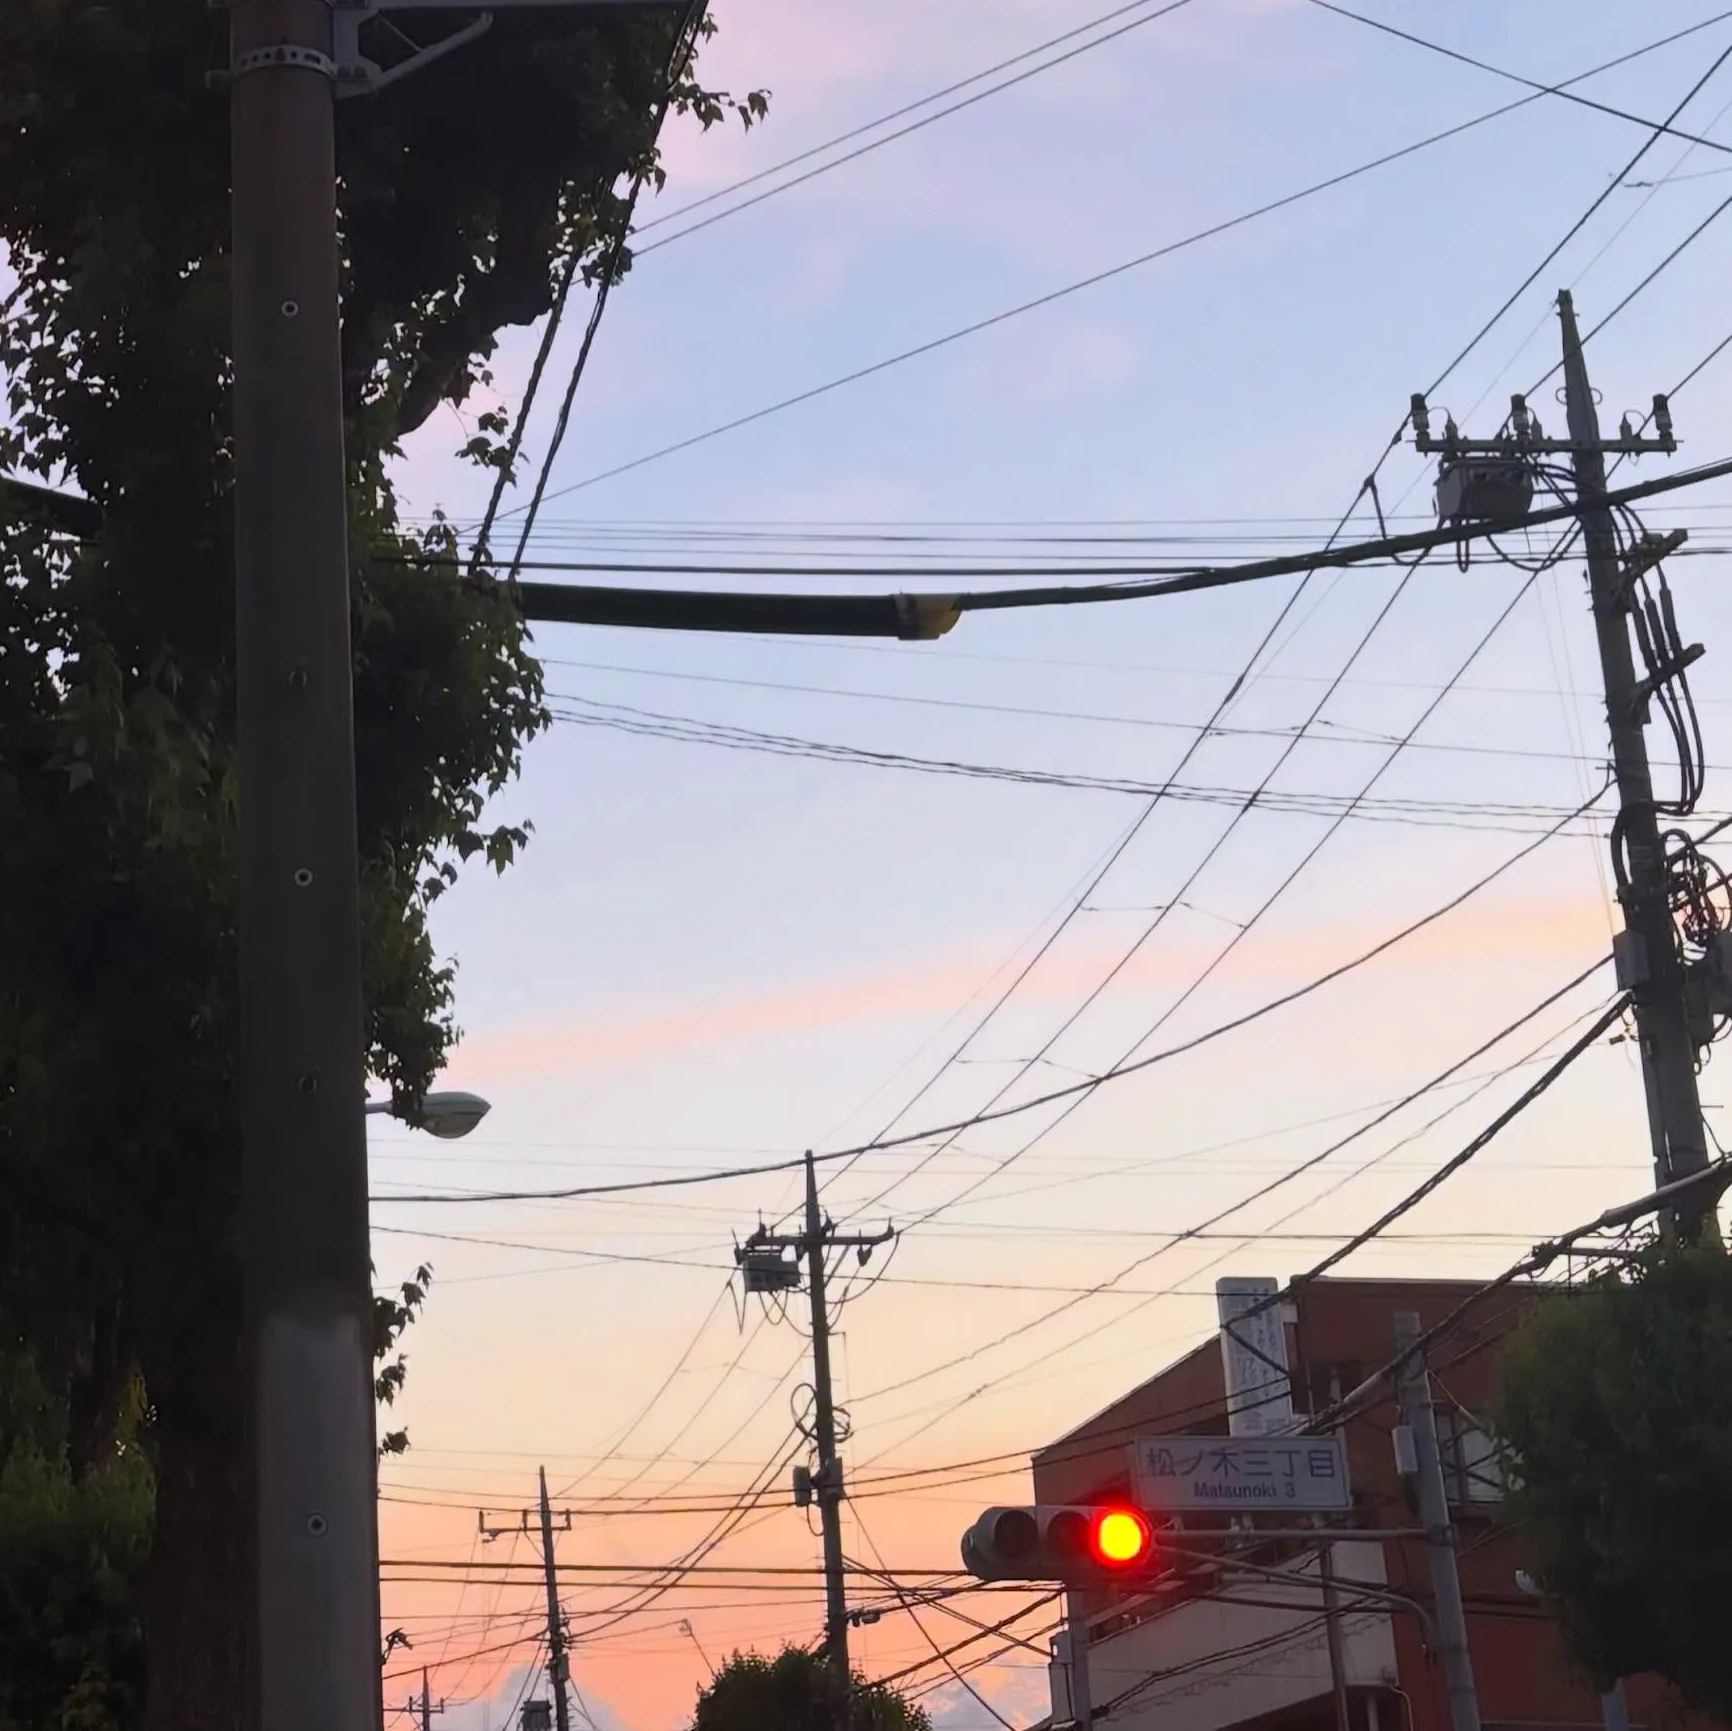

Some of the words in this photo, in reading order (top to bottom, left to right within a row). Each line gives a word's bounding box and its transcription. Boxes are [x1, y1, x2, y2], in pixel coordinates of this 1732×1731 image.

[1145, 1447, 1335, 1478] 松ノ木三丁目
[1194, 1481, 1277, 1500] Matsunoki
[1284, 1482, 1297, 1500] 3
